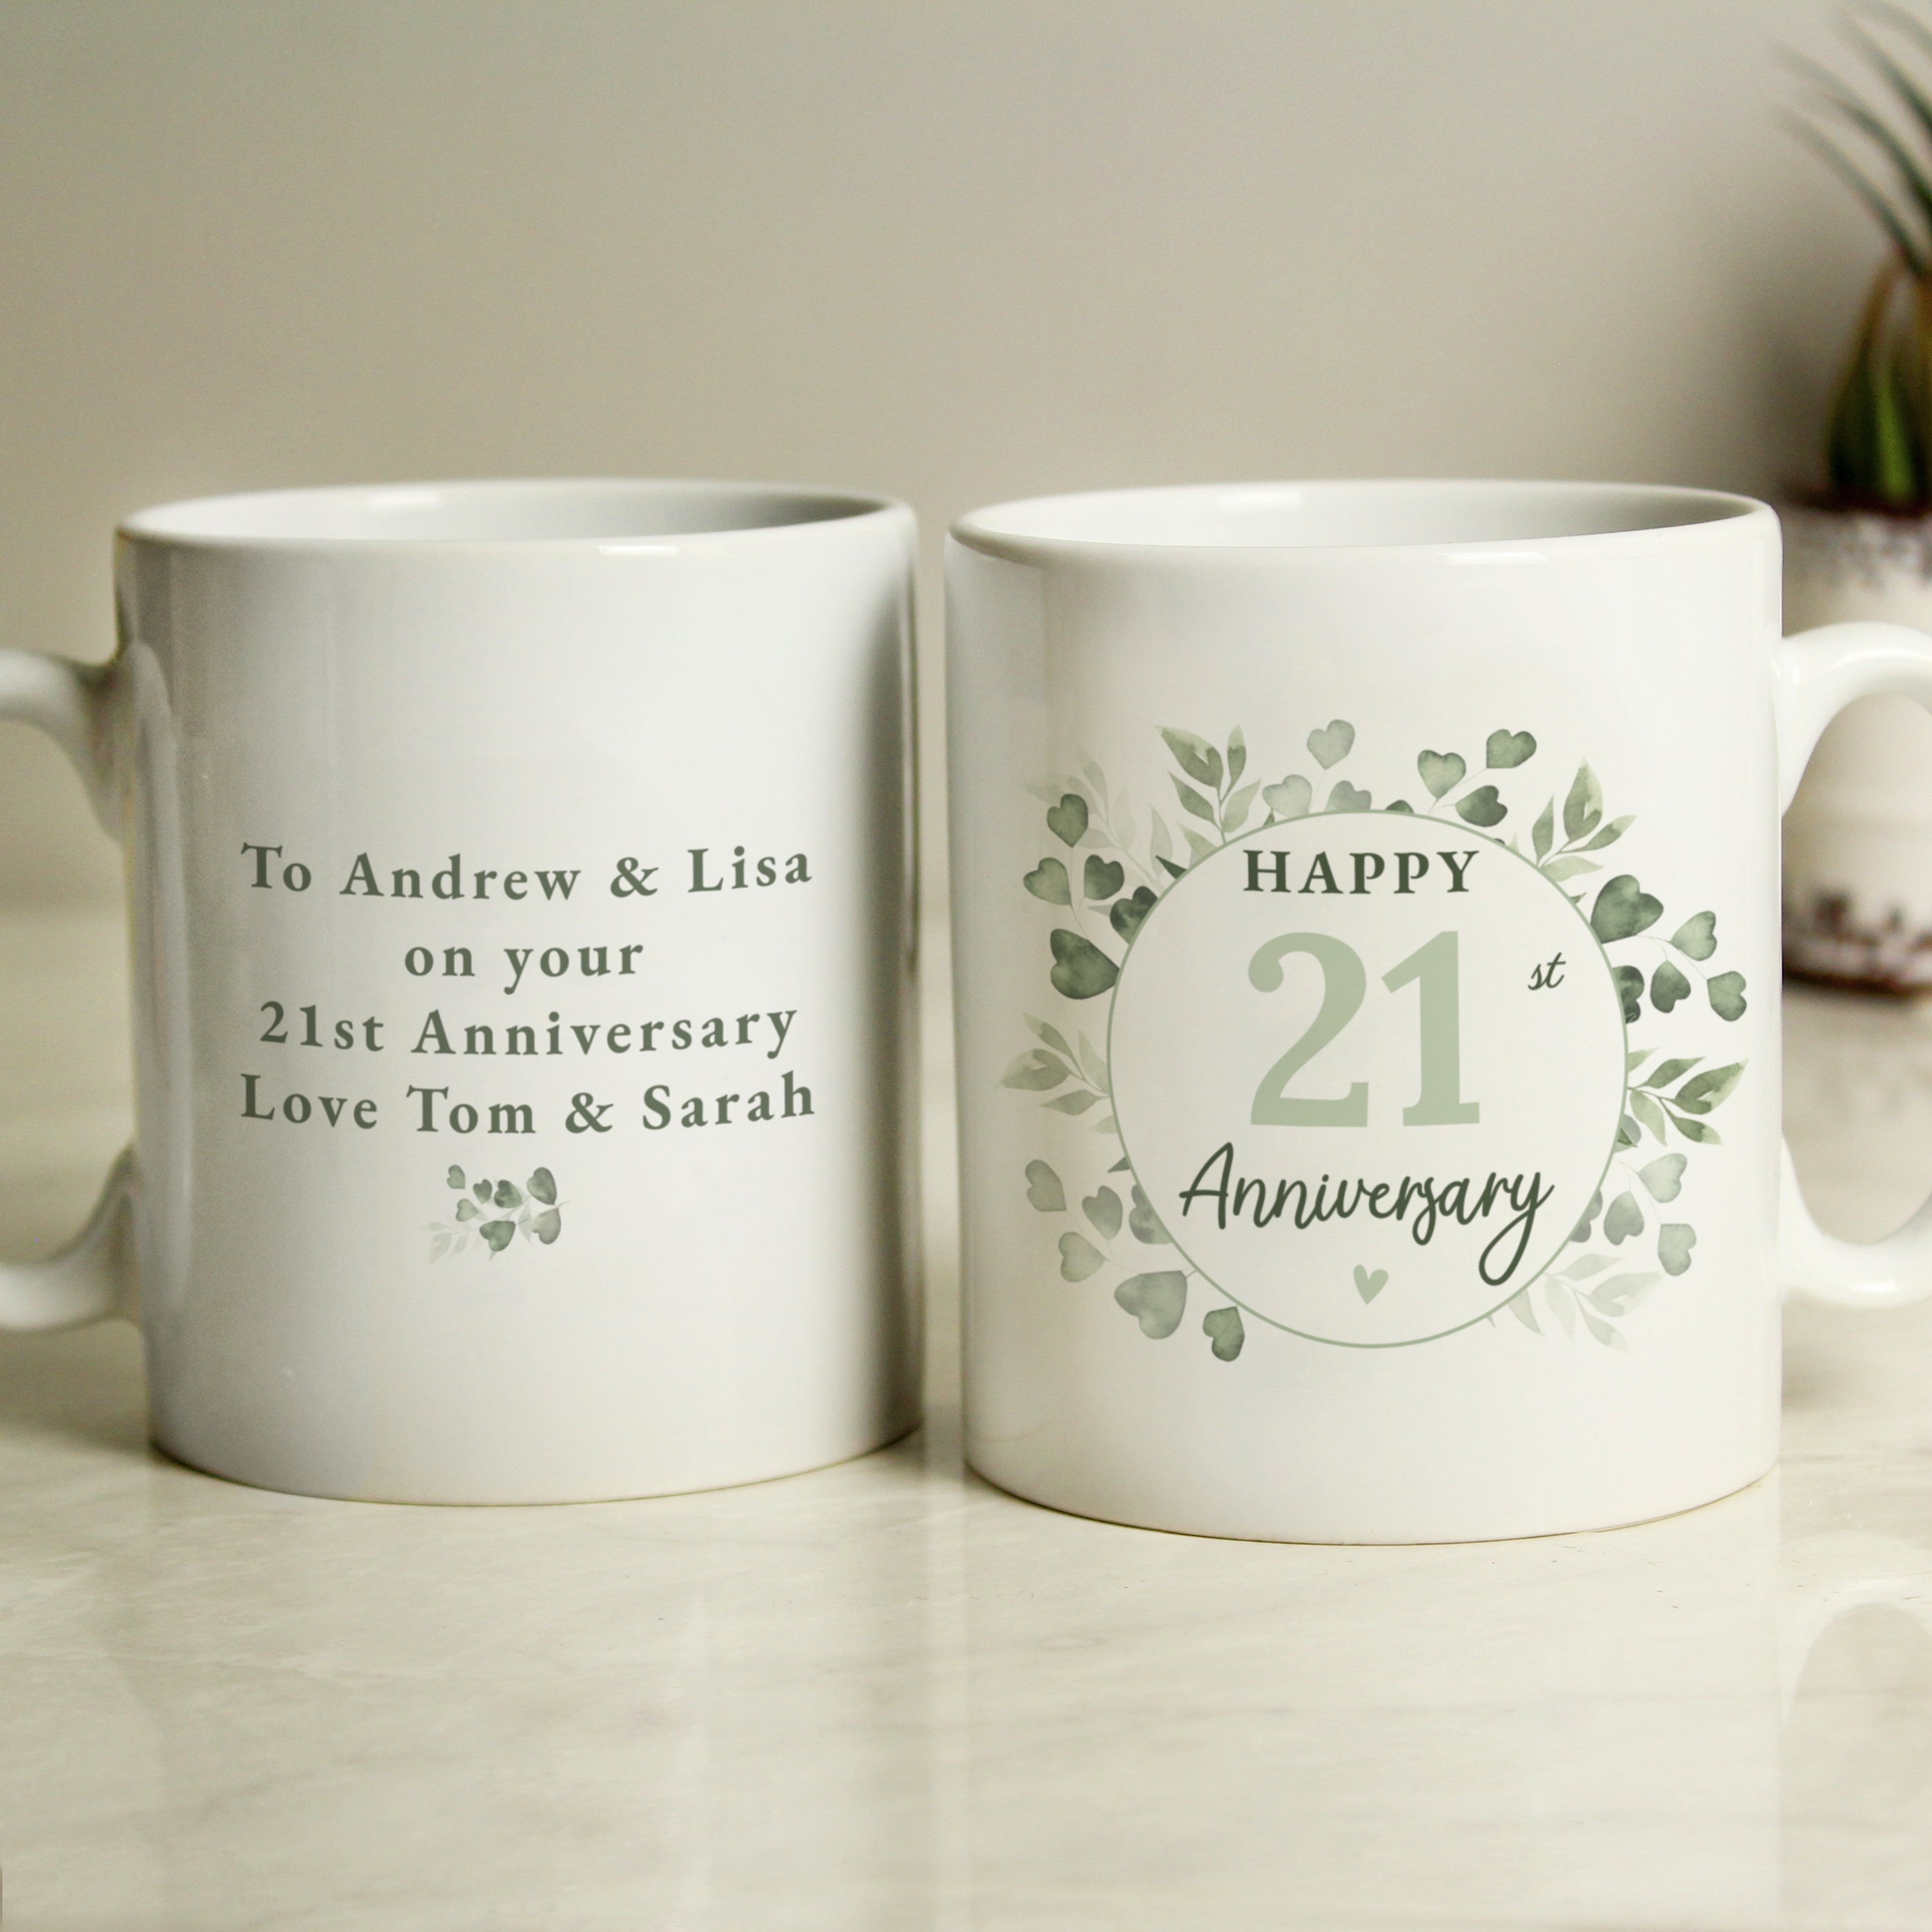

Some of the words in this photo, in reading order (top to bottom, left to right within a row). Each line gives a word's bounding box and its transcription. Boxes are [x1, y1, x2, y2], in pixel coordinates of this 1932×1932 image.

[241, 842, 312, 892] To
[339, 851, 582, 901] Andrew
[609, 856, 659, 898] &
[687, 845, 812, 894] Lisa
[1241, 849, 1480, 896] HAPPY
[404, 945, 475, 977] on
[503, 944, 644, 996] your
[259, 1000, 384, 1052] 21st
[410, 1009, 798, 1060] Anniversary
[1249, 931, 1480, 1127] 21
[1527, 952, 1567, 992] st
[240, 1073, 377, 1130] Love
[406, 1084, 536, 1134] Tom
[564, 1092, 614, 1134] &
[642, 1071, 815, 1131] Sarah
[1179, 1142, 1555, 1286] Anniversary
